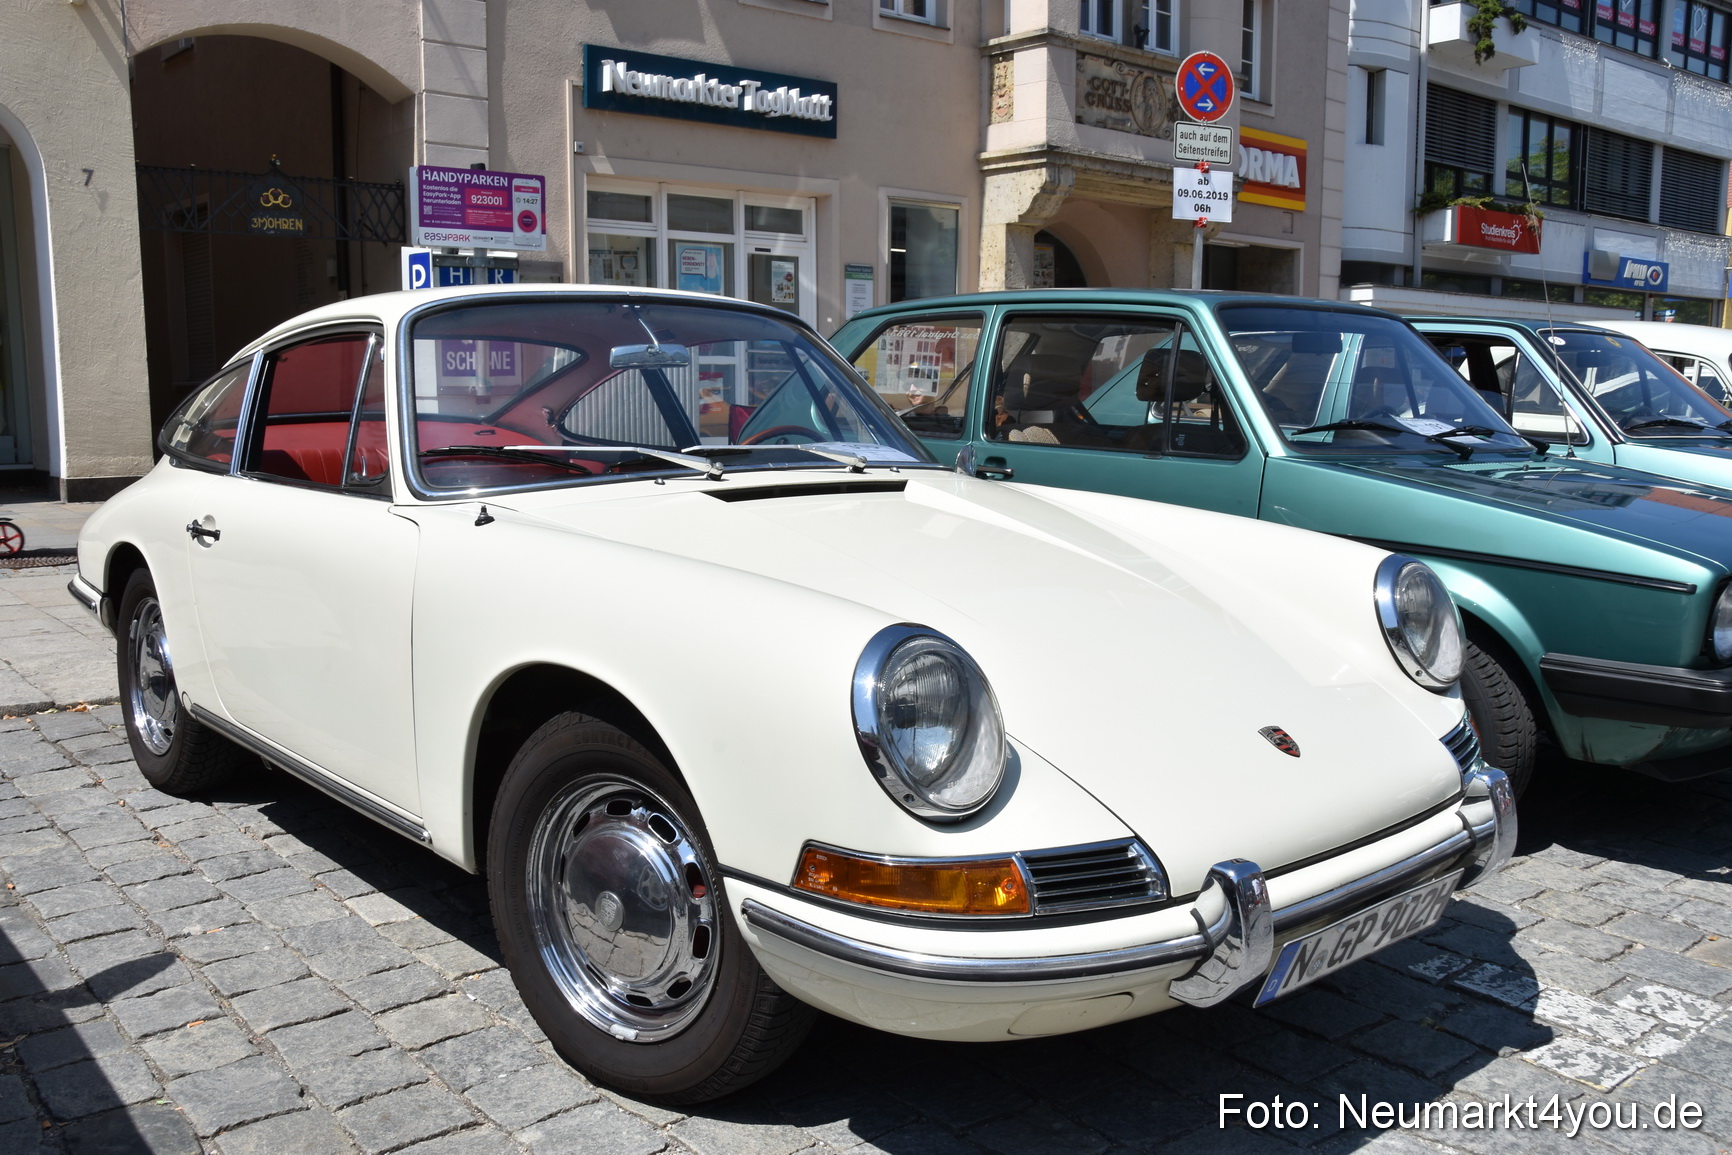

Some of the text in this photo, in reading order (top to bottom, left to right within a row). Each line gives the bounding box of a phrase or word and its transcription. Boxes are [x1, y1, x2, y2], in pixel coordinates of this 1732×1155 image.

[601, 58, 833, 122] Neumarkter Tagblatt
[1179, 130, 1228, 144] auch auf dem
[1178, 143, 1229, 158] Seitenstreifen
[1239, 143, 1301, 189] ORMA
[82, 168, 95, 187] 7
[422, 169, 509, 188] HANDYPARKEN
[1197, 176, 1210, 186] ab
[422, 184, 459, 193] Kostenlos die
[422, 191, 462, 200] EasyPark-App
[1177, 188, 1229, 201] 09.06.2019
[422, 197, 462, 206] herunterladen
[470, 194, 503, 206] 923001
[522, 197, 539, 205] 14:27
[1193, 203, 1211, 213] 06h
[1480, 222, 1516, 239] Studienkreis
[411, 263, 427, 290] P
[449, 266, 505, 285] HIR
[446, 350, 512, 371] SCHNE
[1282, 878, 1459, 989] N GP 902H
[1267, 979, 1278, 993] D
